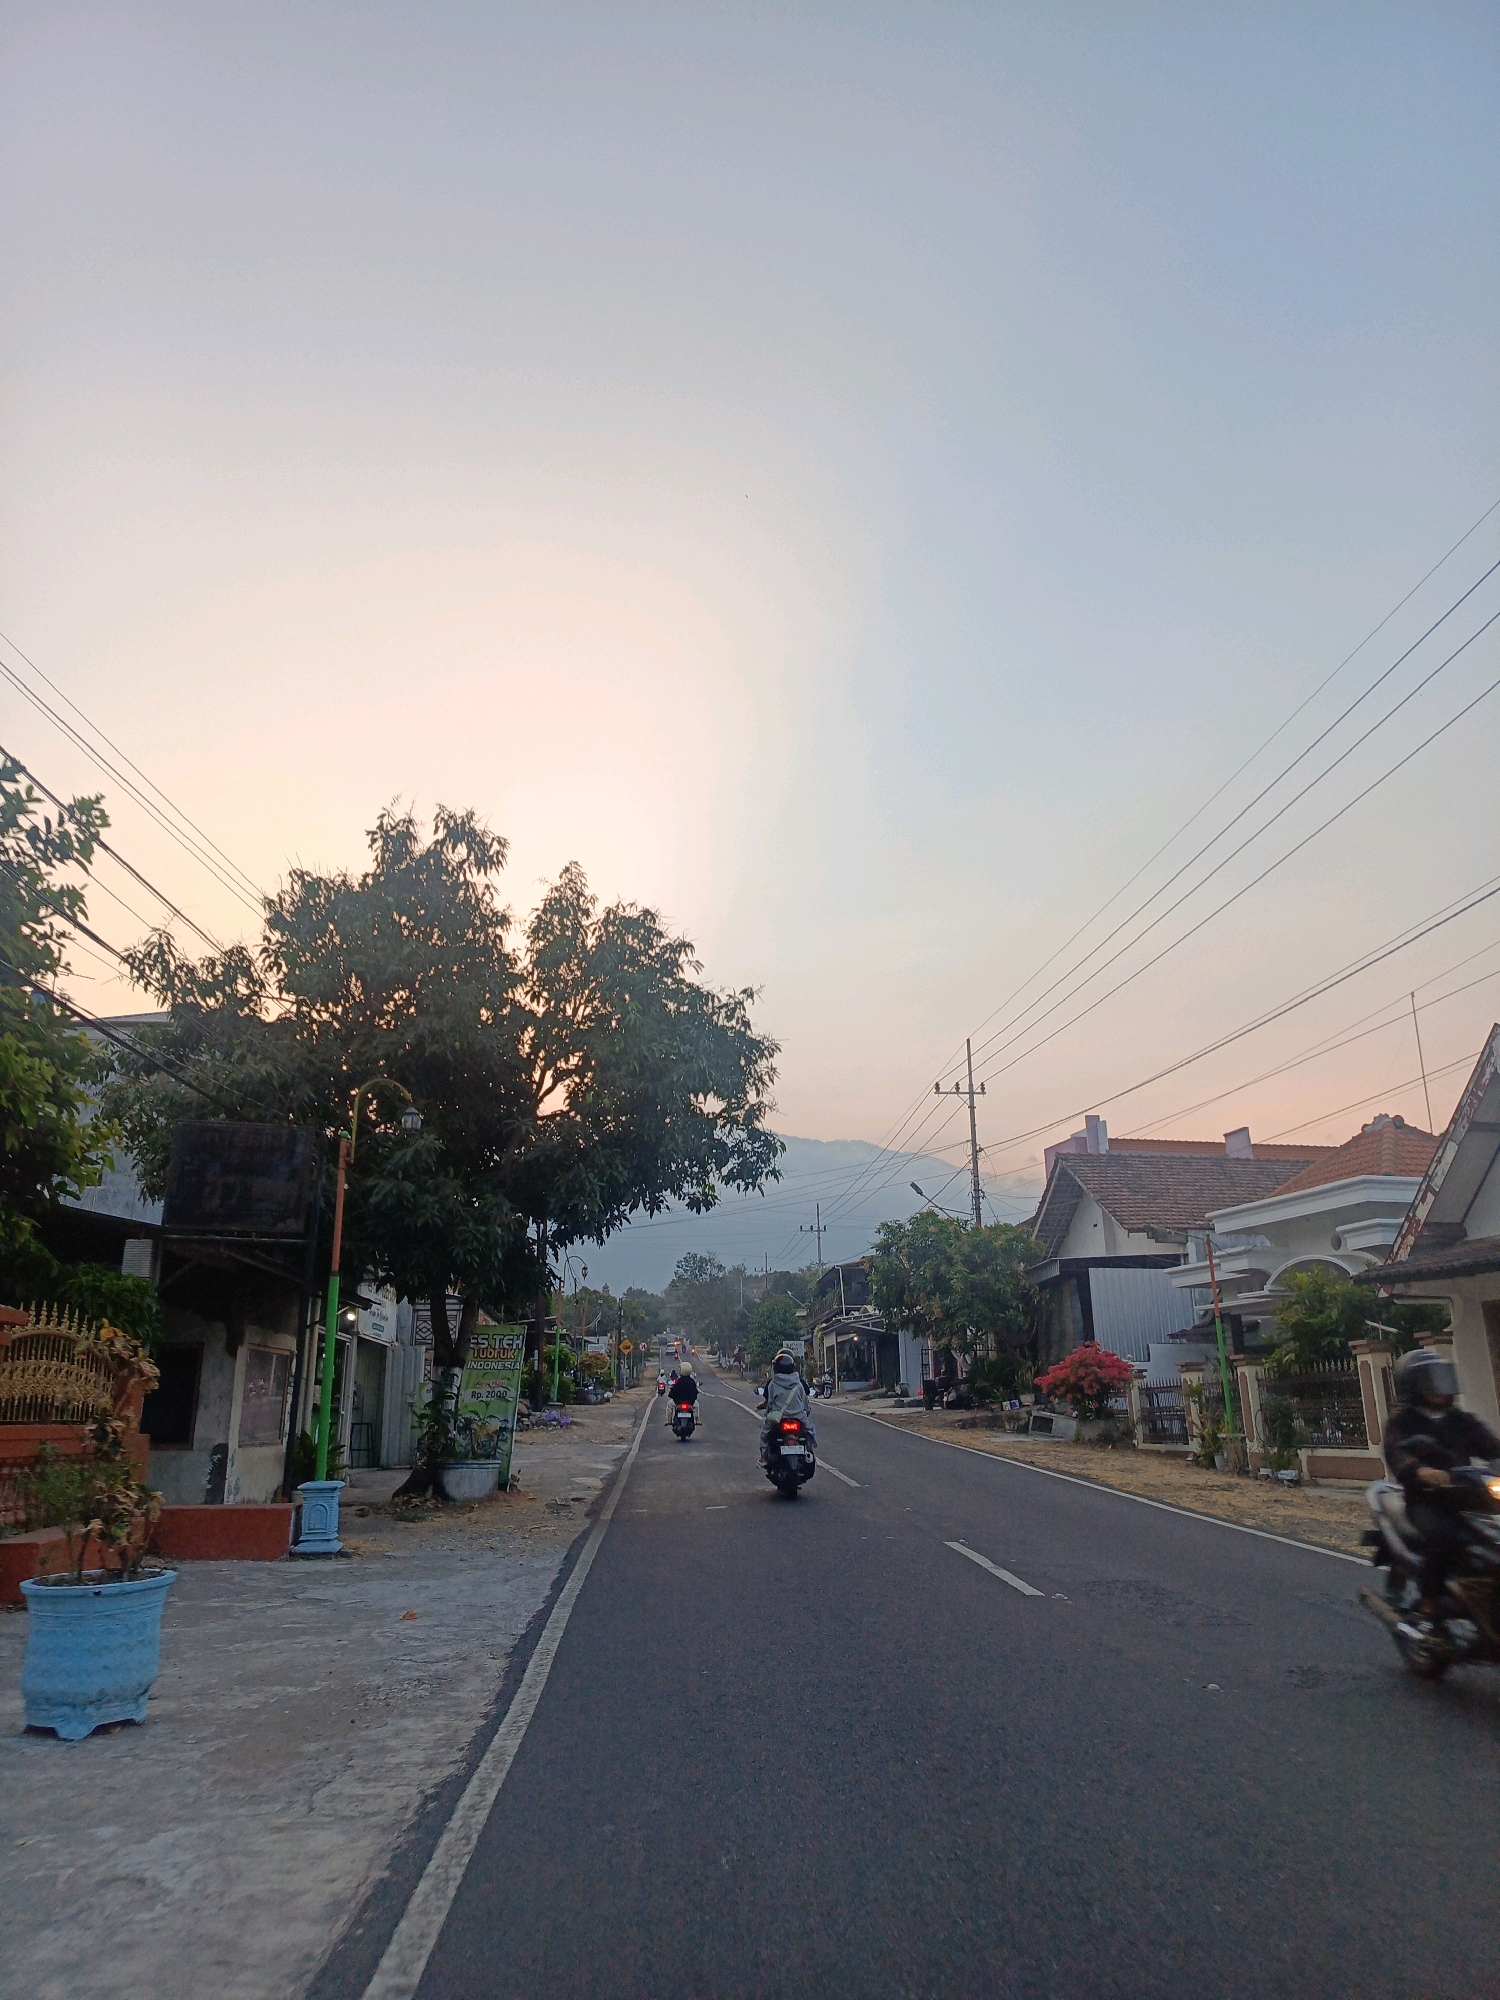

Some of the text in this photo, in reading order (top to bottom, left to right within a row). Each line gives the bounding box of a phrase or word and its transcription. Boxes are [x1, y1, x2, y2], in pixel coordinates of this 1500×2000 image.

[469, 1333, 524, 1349] ES TEH
[473, 1346, 515, 1359] Tubruk
[467, 1360, 520, 1370] INDONESIA
[471, 1390, 508, 1400] Rp. 2000
